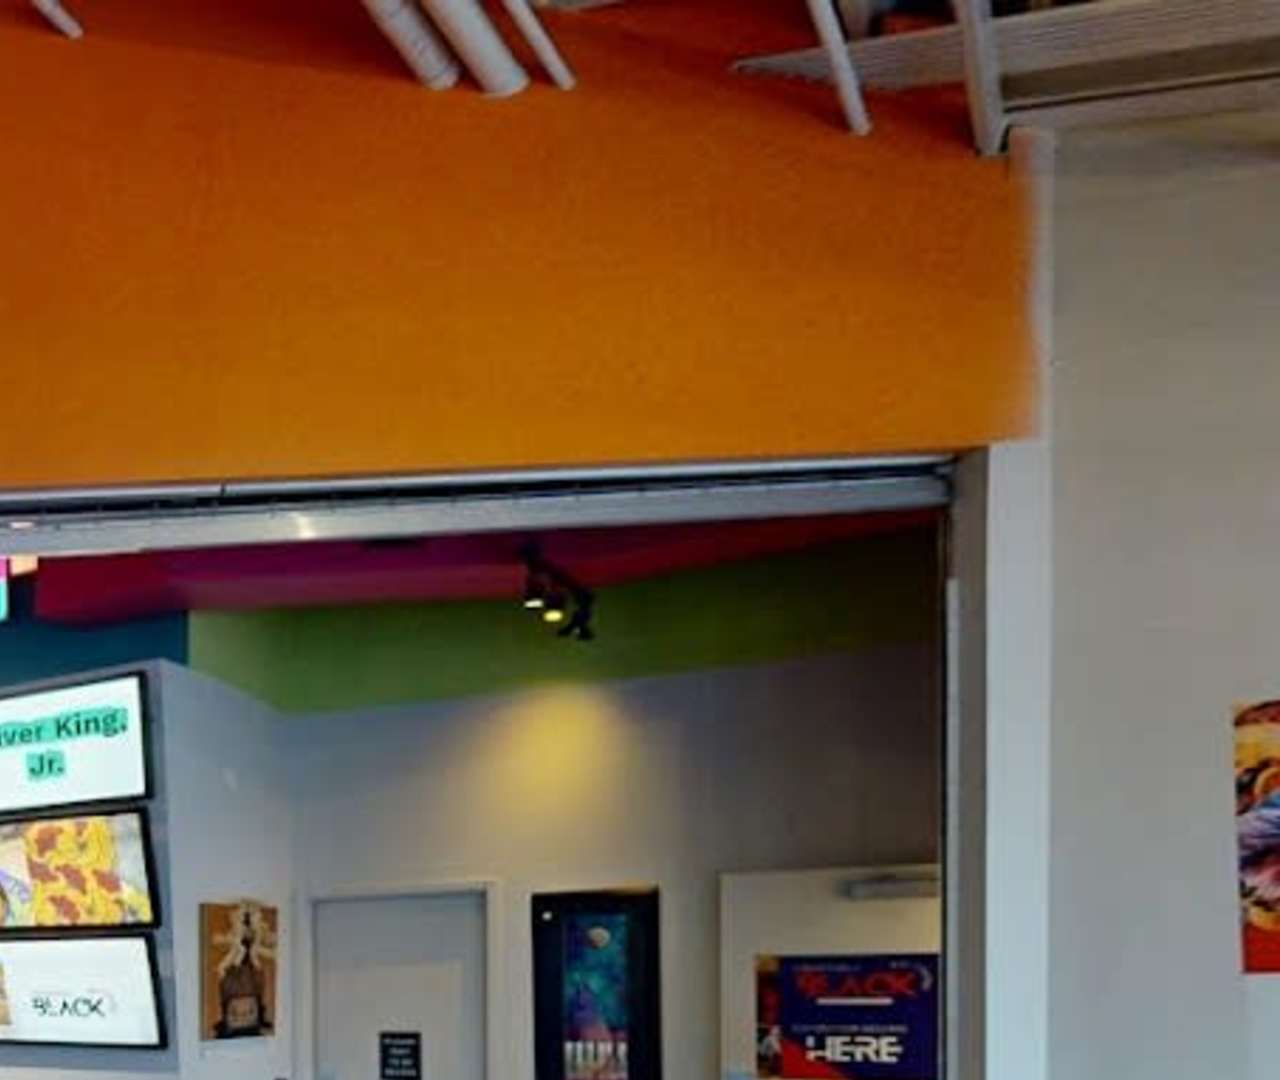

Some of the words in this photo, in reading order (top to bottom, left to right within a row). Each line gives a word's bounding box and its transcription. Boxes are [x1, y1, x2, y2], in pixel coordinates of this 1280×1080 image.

[29, 754, 64, 776] Jr.
[797, 970, 917, 997] BACK
[806, 1035, 903, 1063] HERE
